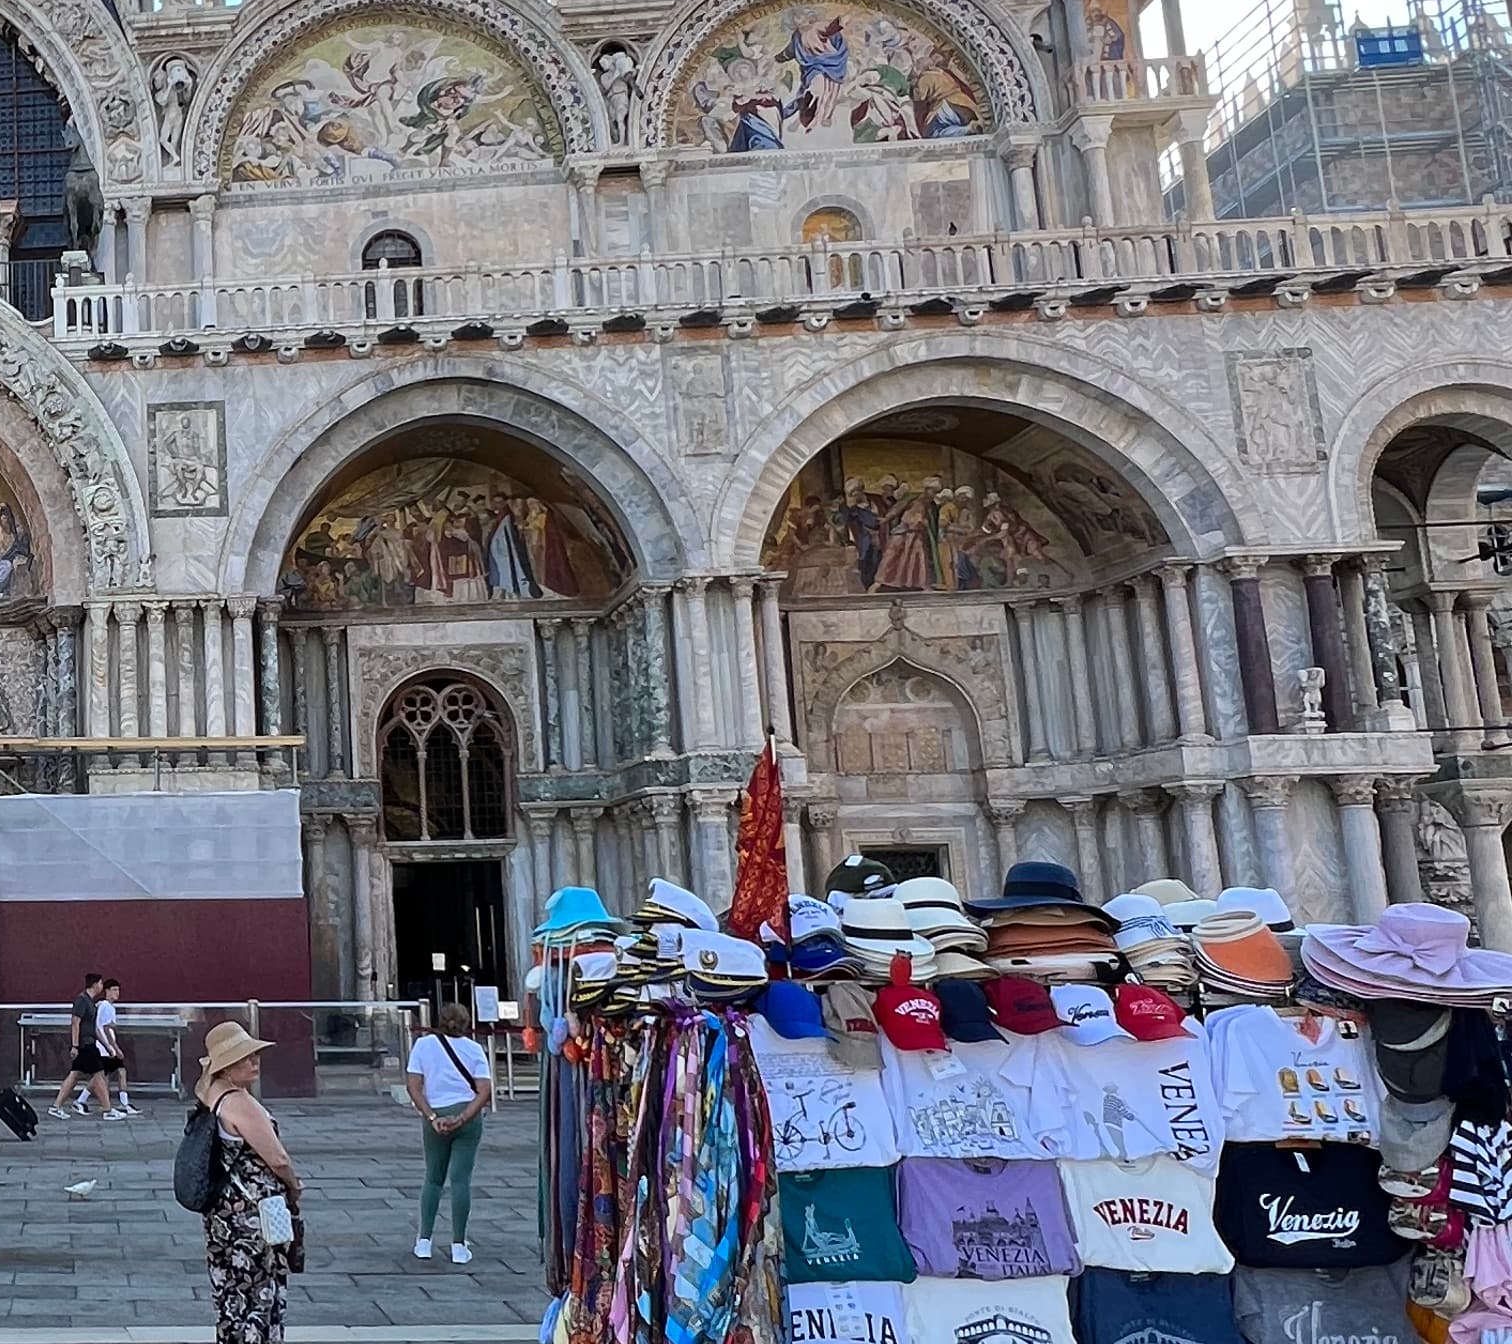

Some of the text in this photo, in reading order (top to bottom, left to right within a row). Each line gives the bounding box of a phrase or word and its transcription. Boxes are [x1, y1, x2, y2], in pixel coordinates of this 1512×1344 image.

[1092, 1198, 1189, 1235] VENEZIA
[1259, 1193, 1360, 1233] Venezia
[962, 1246, 1046, 1264] VENEZIA
[1002, 1263, 1050, 1276] ITALIA
